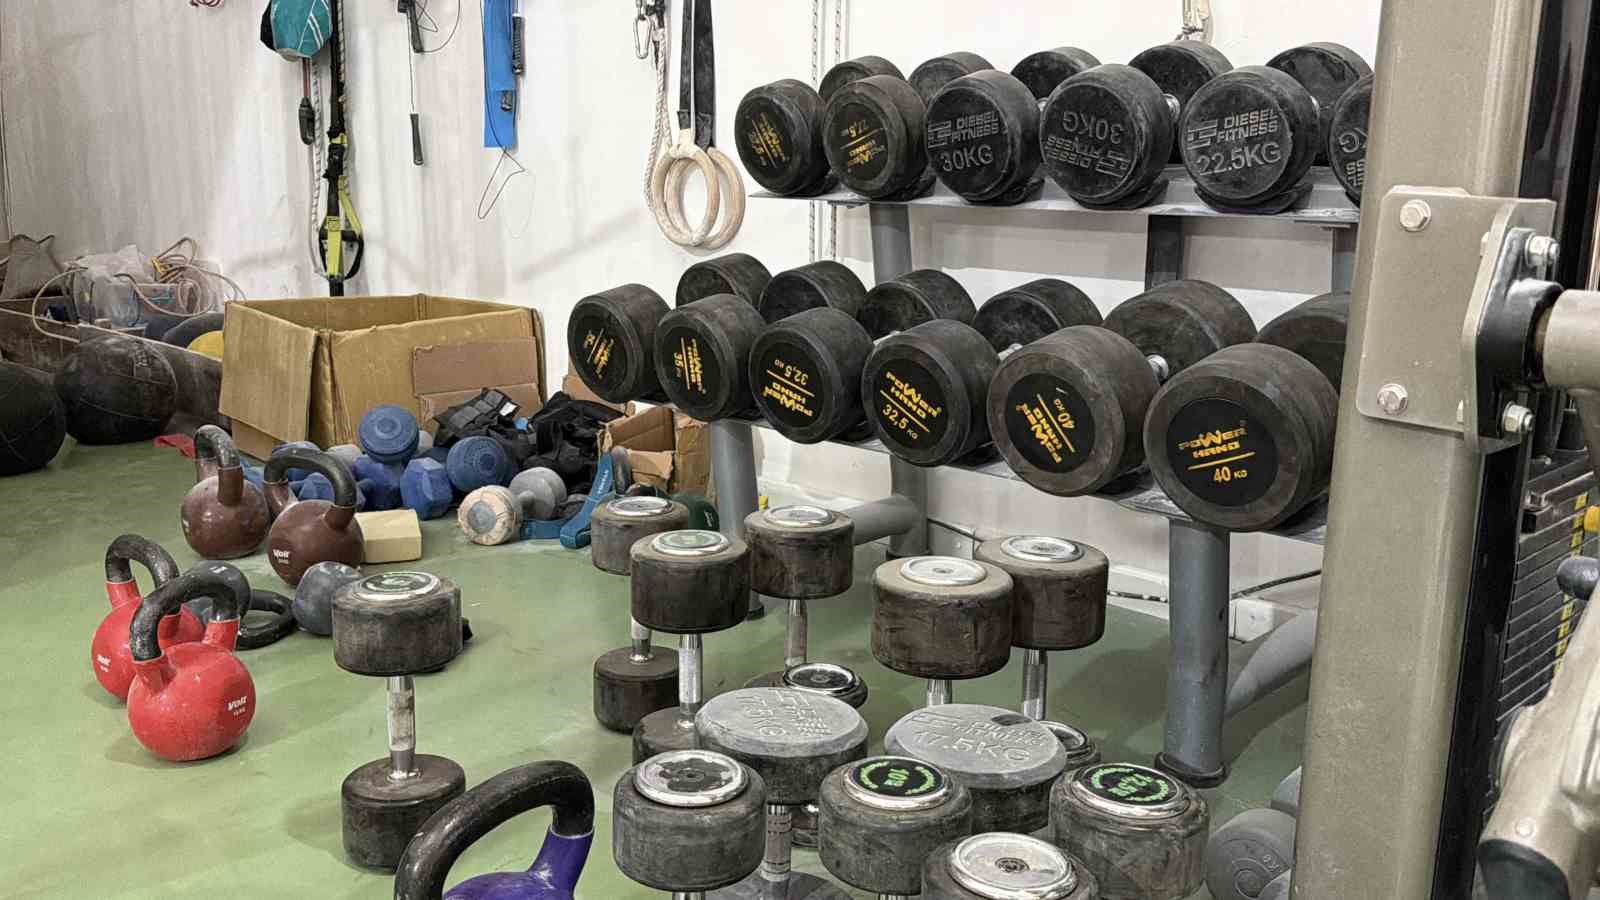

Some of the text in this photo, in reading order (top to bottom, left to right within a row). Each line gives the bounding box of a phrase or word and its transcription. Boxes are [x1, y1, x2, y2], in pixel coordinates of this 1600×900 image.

[956, 111, 999, 129] DIESEL
[1062, 111, 1124, 144] 30KG
[1224, 108, 1279, 129] DIESEL
[952, 123, 999, 142] FITNESS
[1216, 120, 1278, 143] FITNESS
[940, 145, 994, 171] 30KG
[1196, 141, 1281, 176] 22.5KG
[772, 382, 806, 405] HAND
[890, 386, 926, 419] HAND
[1032, 407, 1063, 450] HAND
[1057, 413, 1075, 429] 40
[1192, 441, 1241, 459] HAND
[1214, 466, 1231, 483] 40
[913, 731, 1033, 762] 17.5KG
